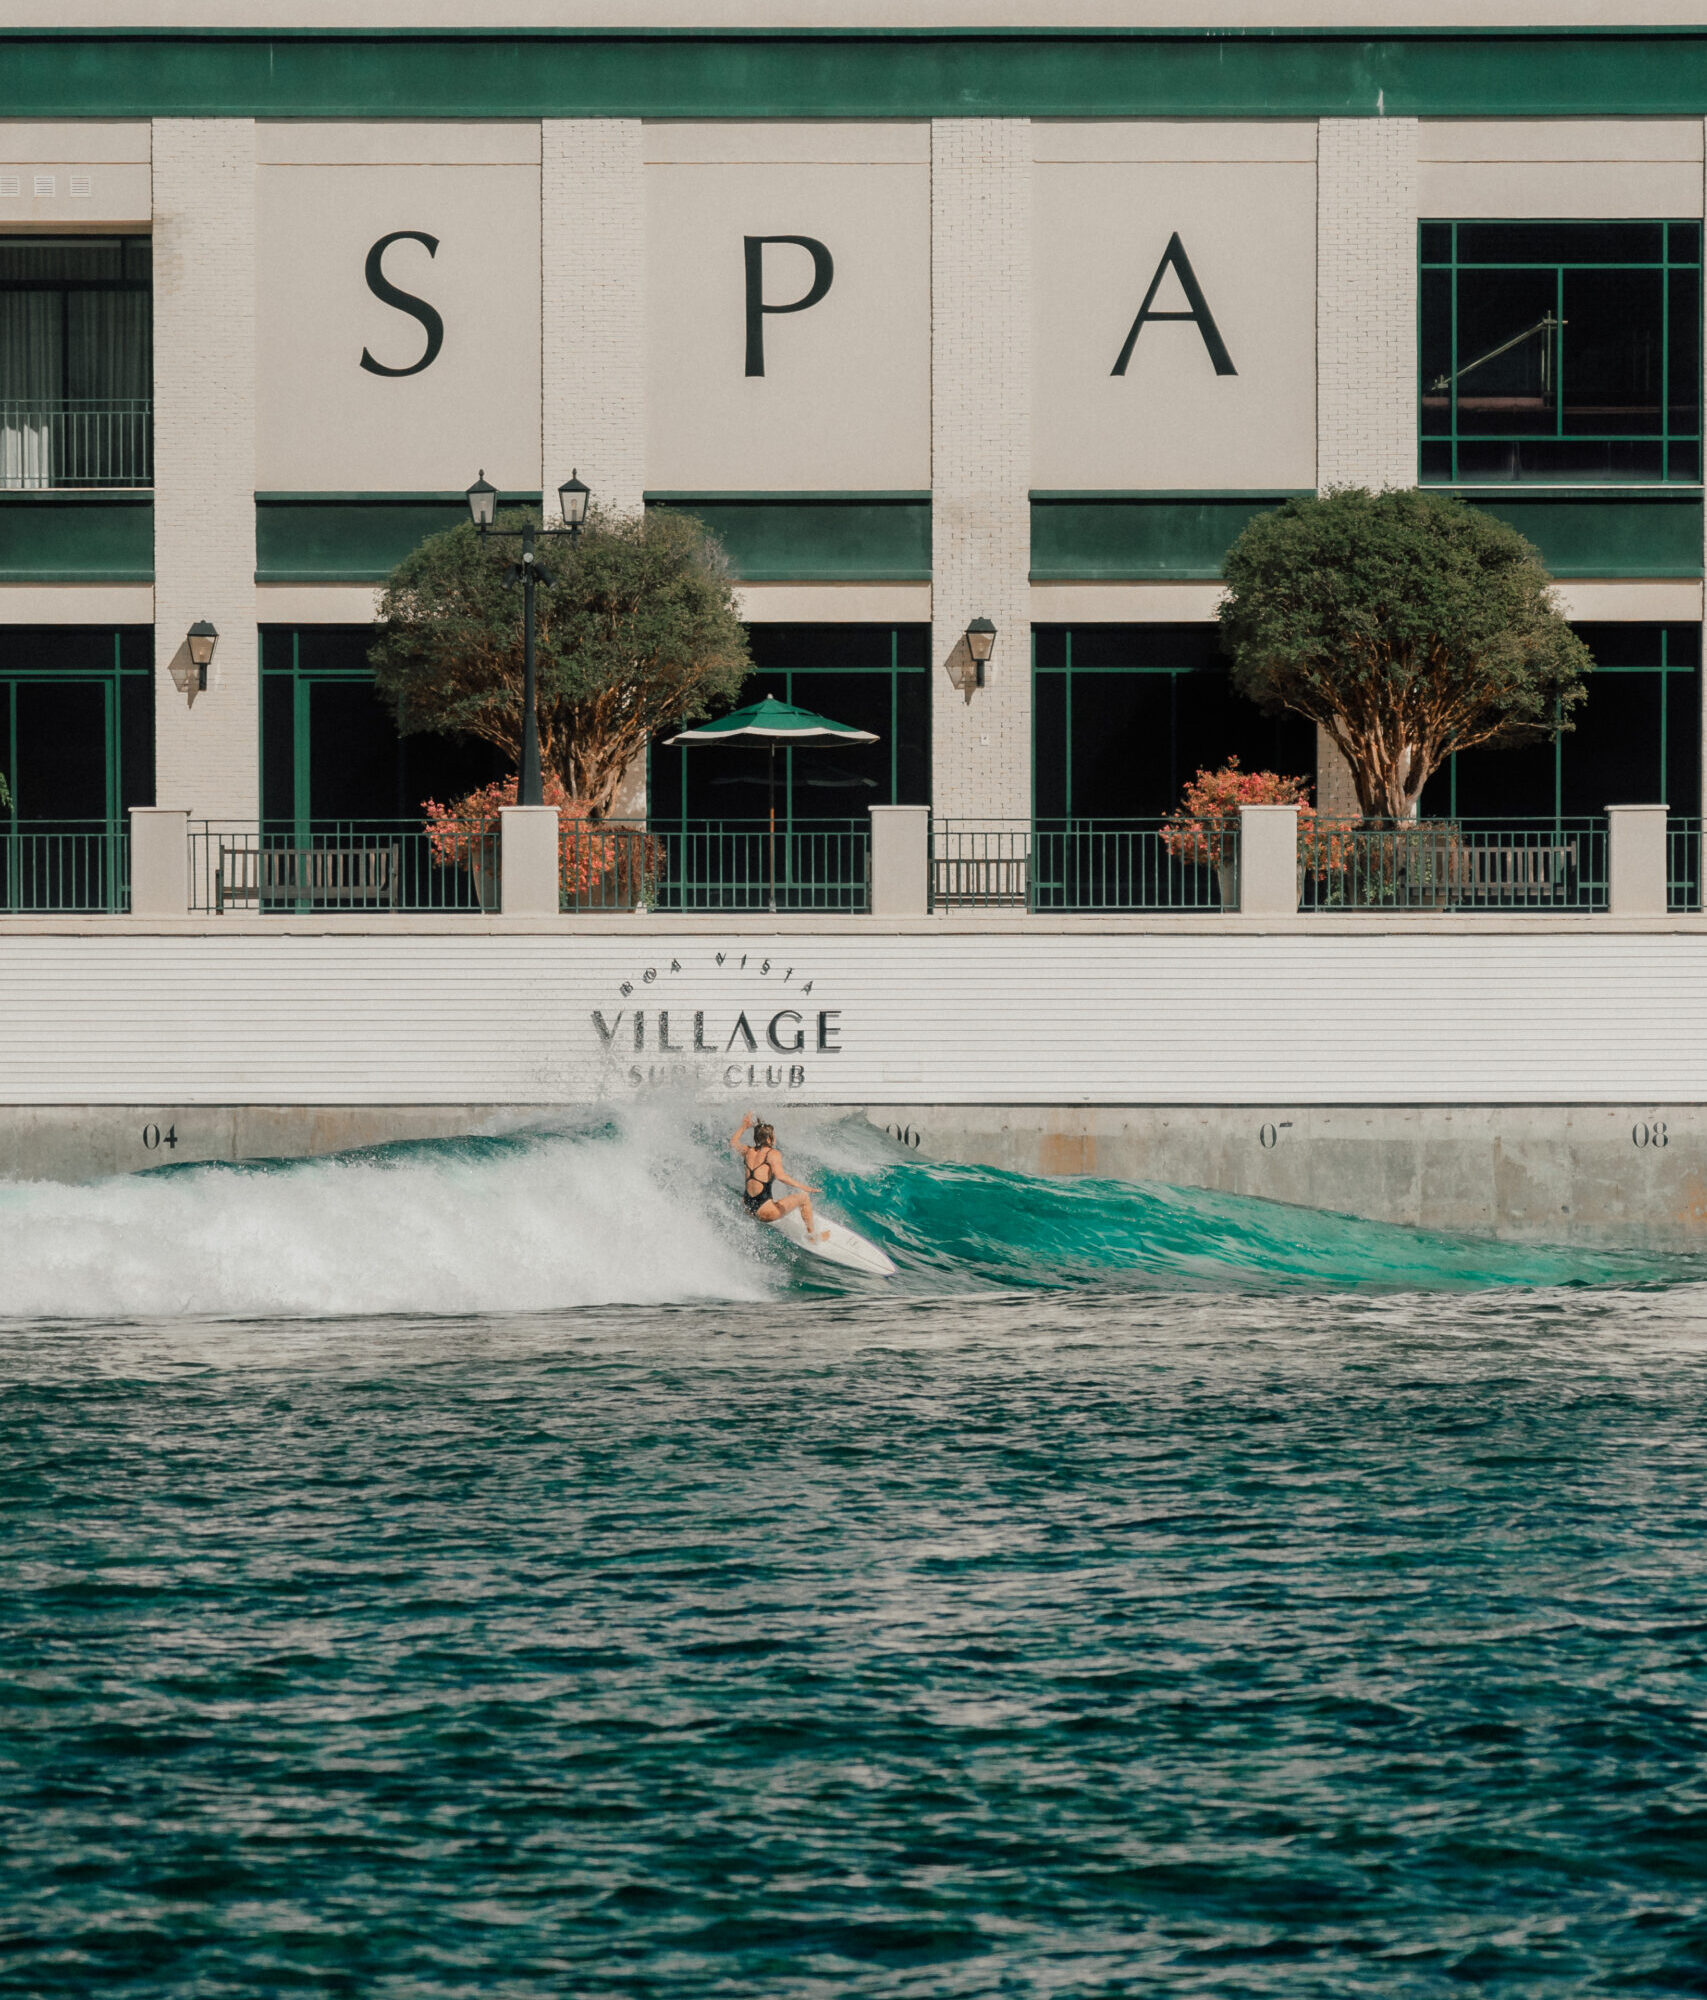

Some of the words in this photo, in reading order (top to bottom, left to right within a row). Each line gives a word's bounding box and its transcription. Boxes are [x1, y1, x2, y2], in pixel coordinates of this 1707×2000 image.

[359, 230, 1238, 377] SPA
[619, 957, 682, 998] BOA
[715, 952, 813, 996] VISTA
[590, 1009, 842, 1054] VILLAGE
[723, 1064, 805, 1088] CLUB
[142, 1122, 178, 1150] 04
[1632, 1121, 1669, 1149] 08
